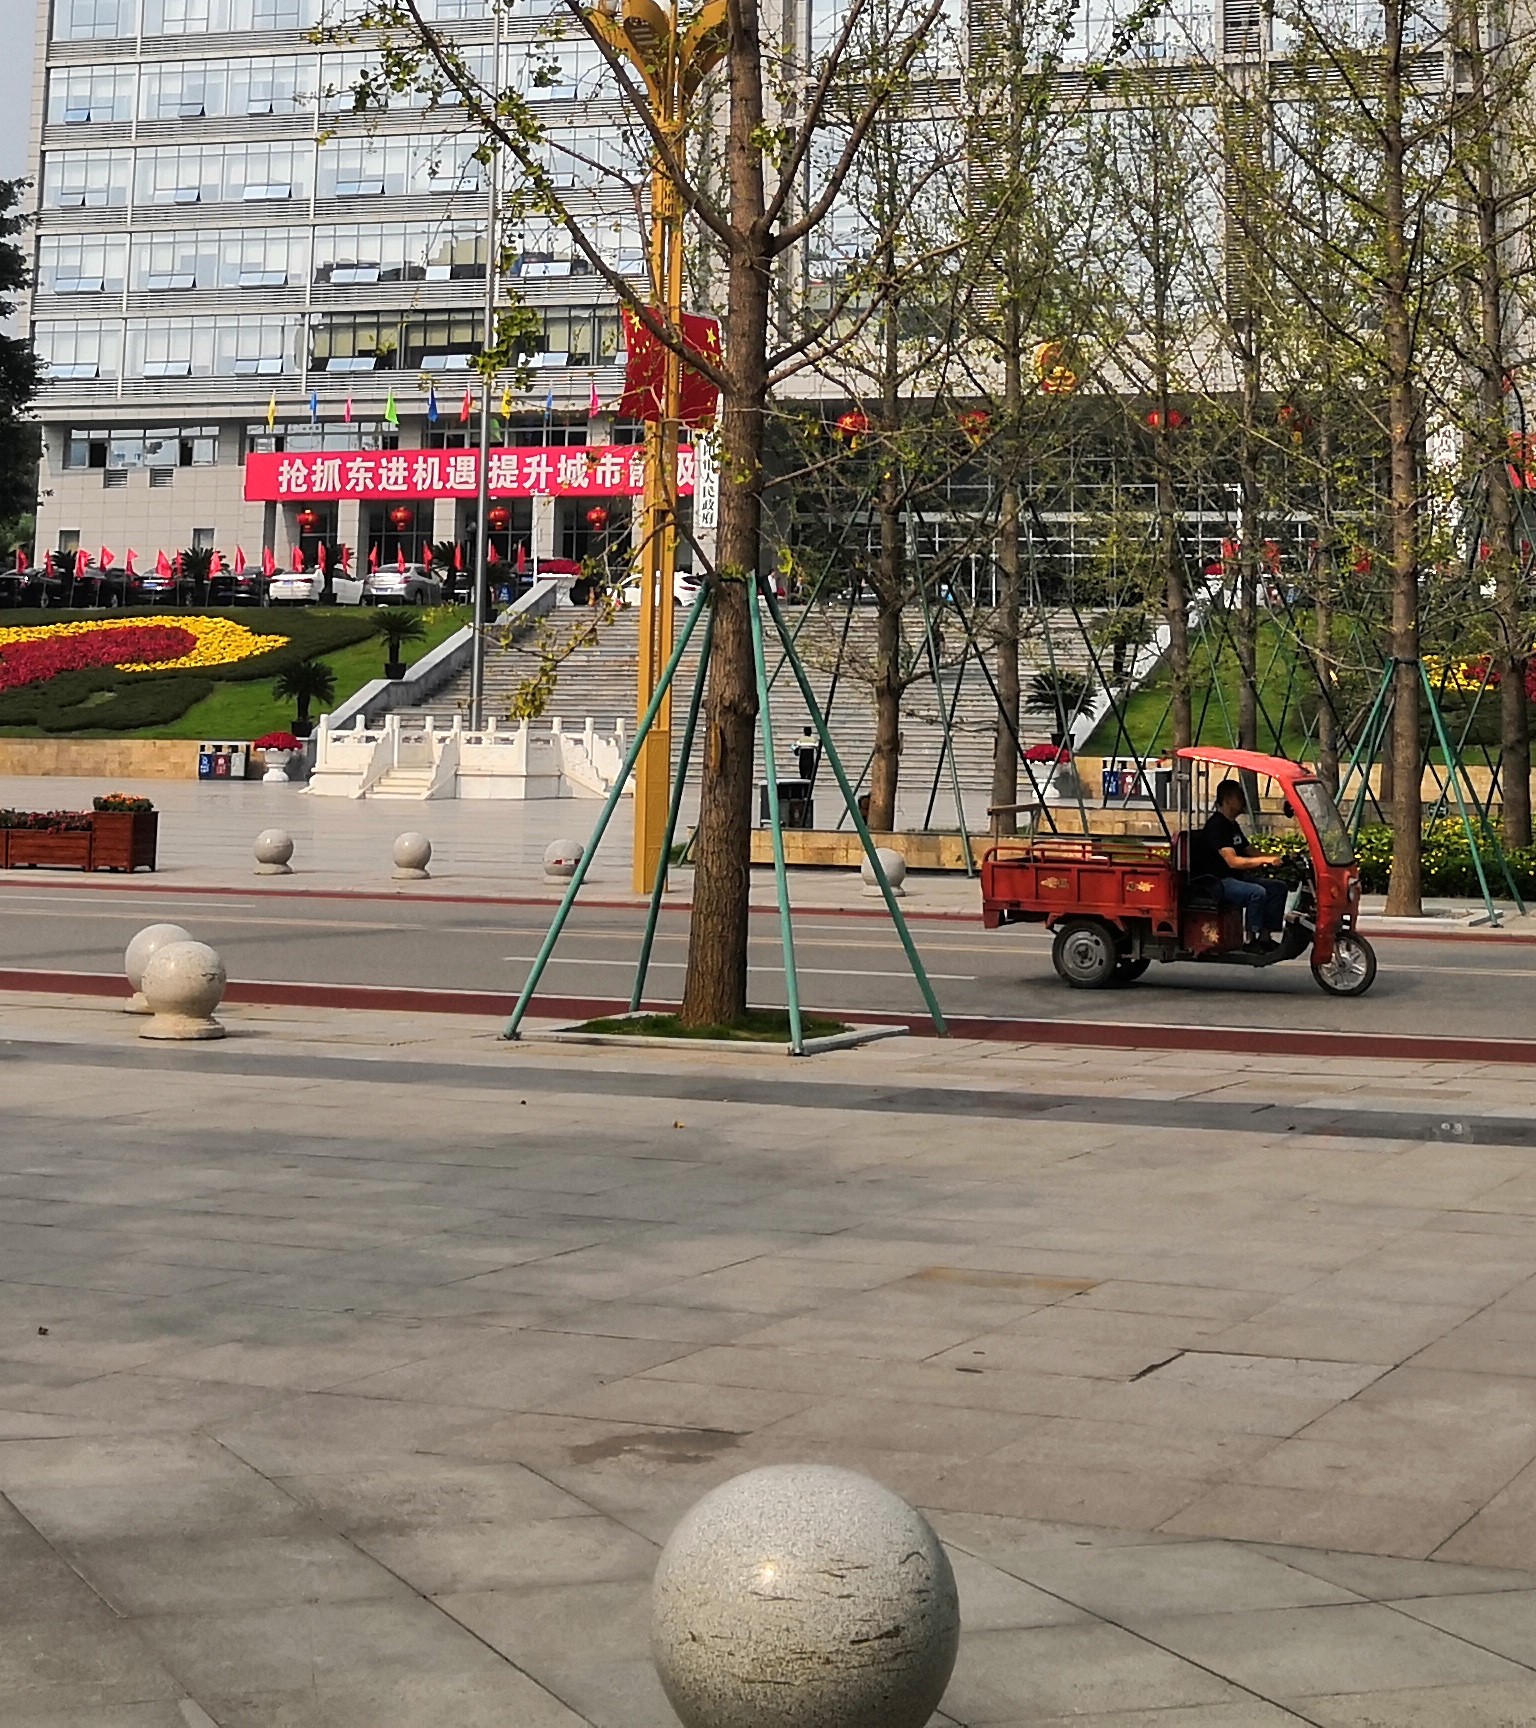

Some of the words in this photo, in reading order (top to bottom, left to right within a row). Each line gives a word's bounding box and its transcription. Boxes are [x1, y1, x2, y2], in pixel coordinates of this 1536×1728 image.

[278, 454, 477, 493] 抢抓东进机遇
